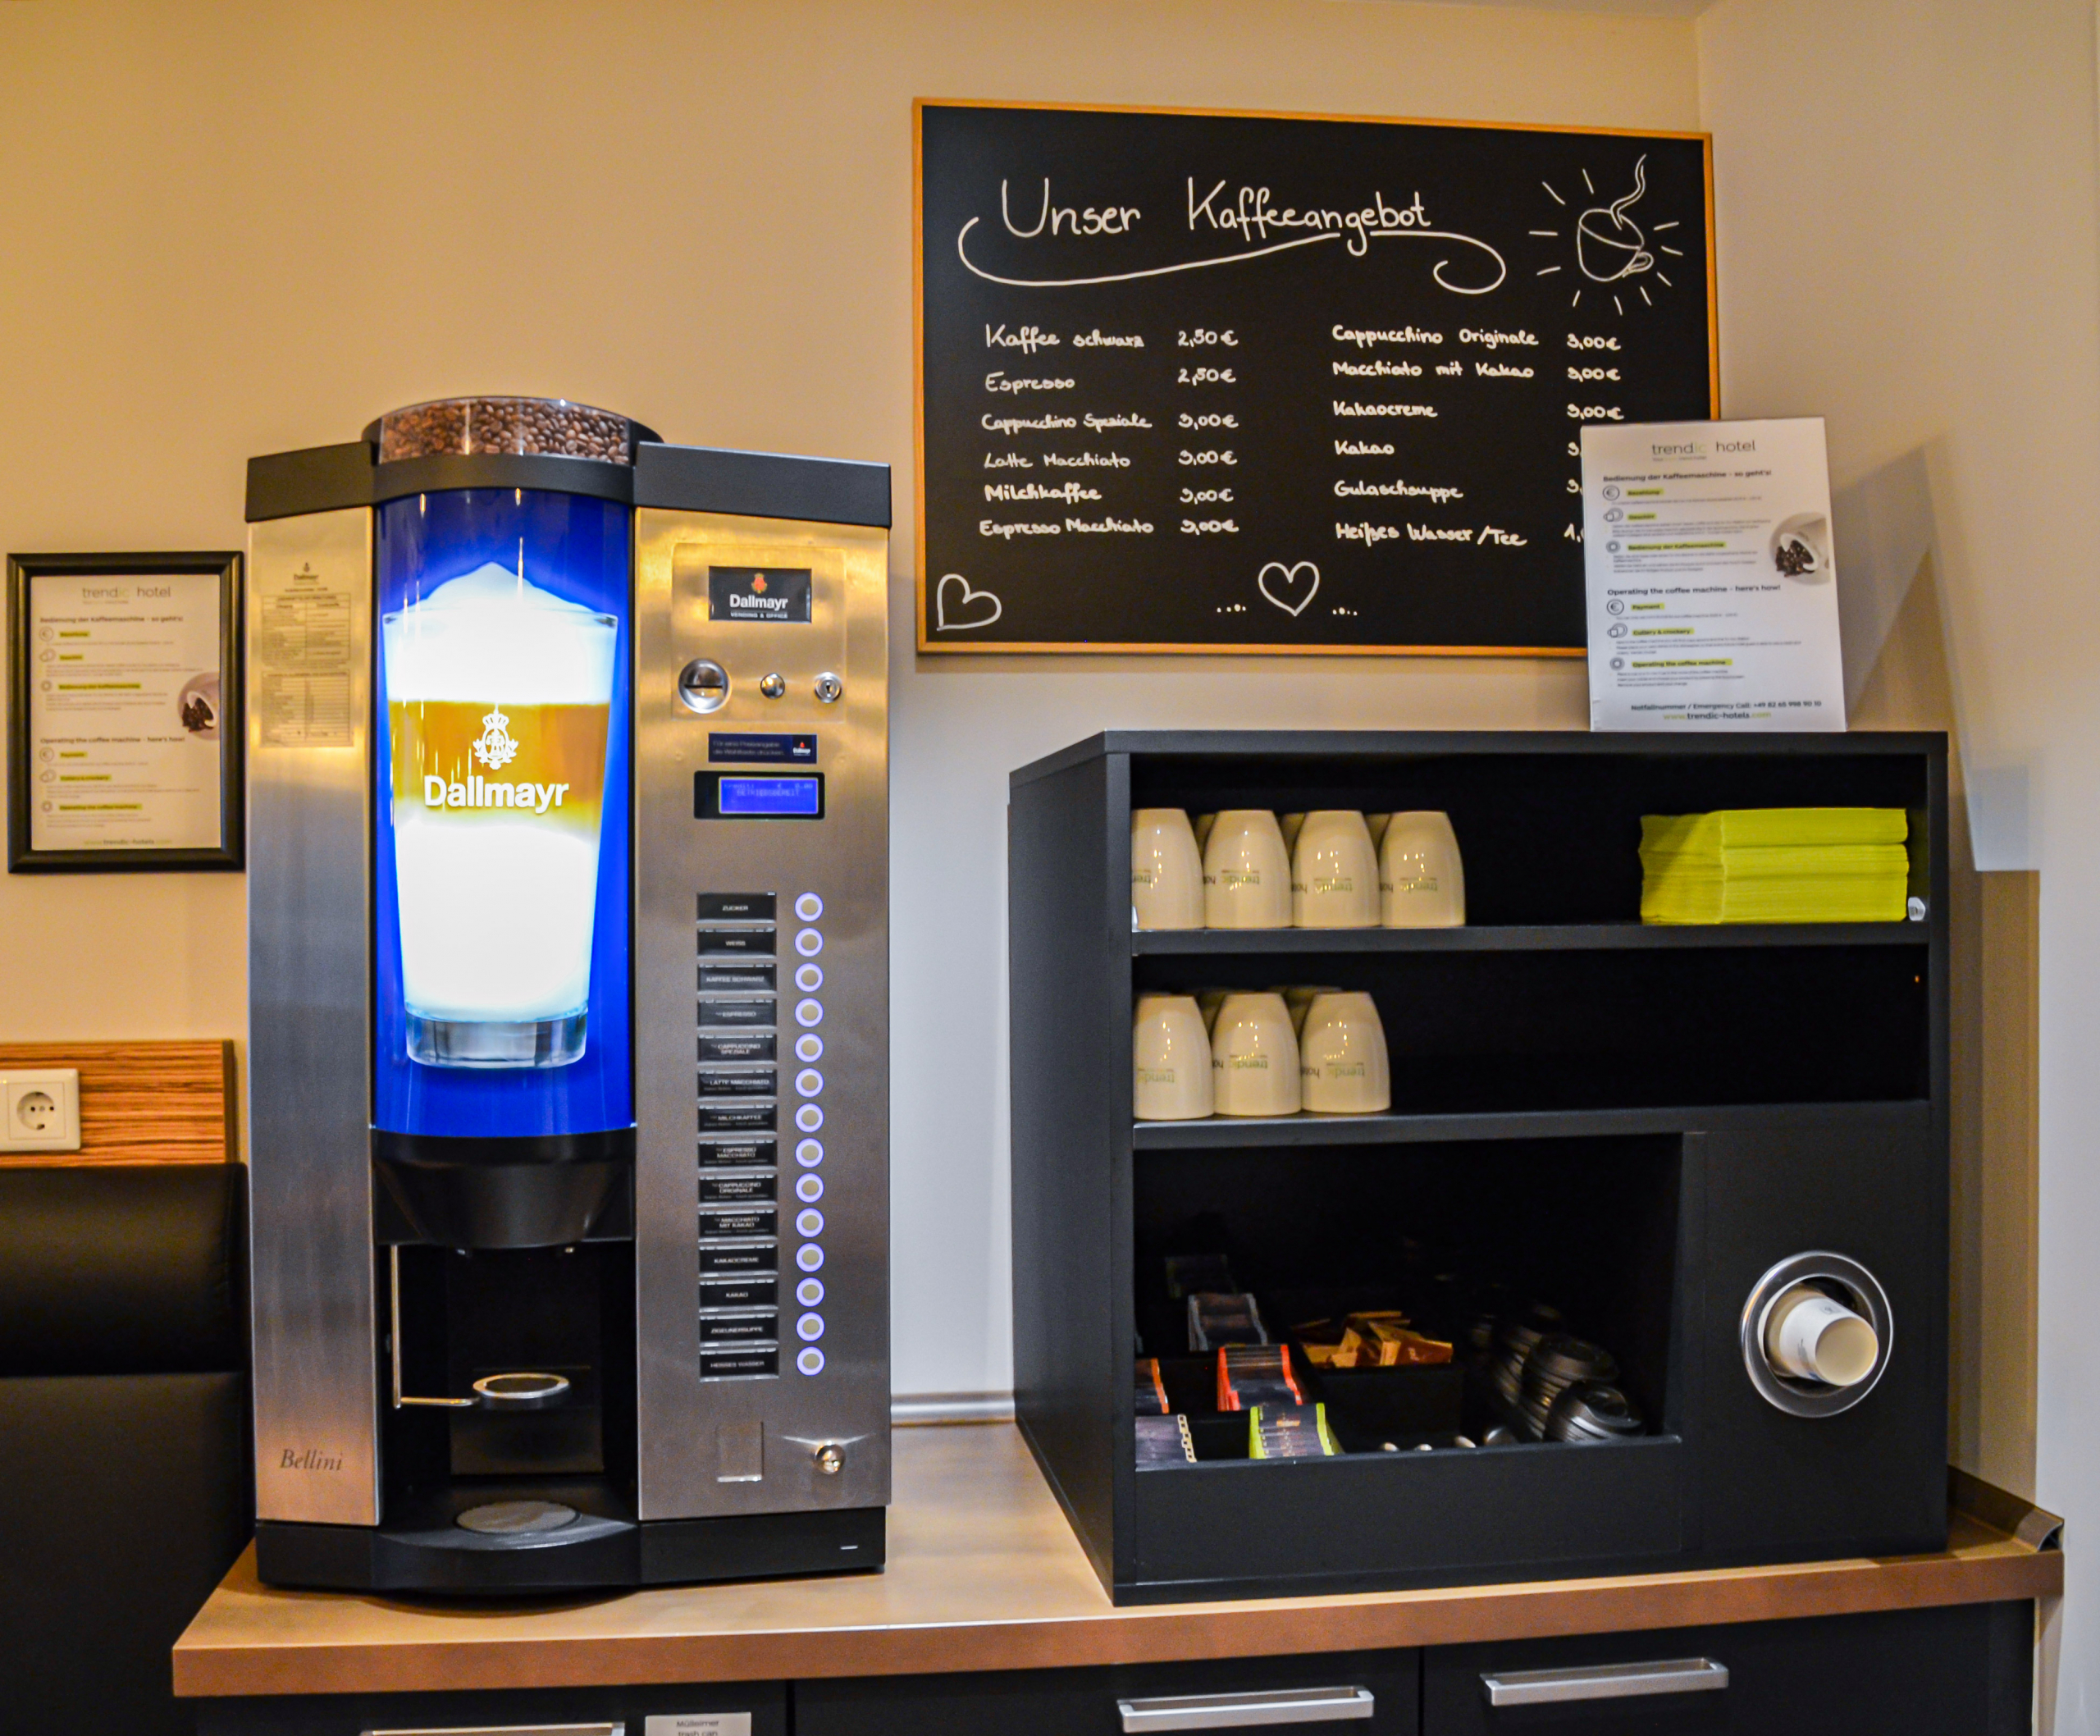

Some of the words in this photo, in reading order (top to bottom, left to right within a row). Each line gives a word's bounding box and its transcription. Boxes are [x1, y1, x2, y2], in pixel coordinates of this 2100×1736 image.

[1001, 177, 1141, 238] Unser
[1187, 176, 1431, 257] Kaffeeangebot
[985, 323, 1061, 354] Kaffee
[1072, 328, 1145, 349] schwarz
[1177, 328, 1239, 348] 2,50€
[1331, 324, 1444, 349] Cappucchino
[1459, 328, 1539, 349] Originale
[1566, 333, 1622, 351] 3,00€
[984, 371, 1075, 395] Espresso
[1177, 367, 1237, 386] 2,50€
[1332, 359, 1422, 377] Macchiato
[1435, 360, 1463, 377] mit
[1475, 362, 1535, 378] Kakao
[1568, 367, 1621, 382] 3,00€
[1332, 400, 1438, 418] Kakaocreme
[1567, 404, 1624, 420] 3,00€
[981, 413, 1077, 436] Cappucchino
[1082, 412, 1153, 433] Speziale
[1178, 413, 1239, 431] 3,00€
[1334, 440, 1395, 455] Kakao
[1567, 441, 1582, 457] 3
[1715, 440, 1756, 452] hotel
[984, 452, 1034, 469] Latte
[1043, 451, 1131, 468] Macchiato
[1178, 450, 1238, 466] 3,00€
[1603, 474, 1646, 482] Bedienung
[1663, 471, 1727, 480] Kaffeemaschine
[984, 482, 1102, 505] Milchkaffee
[1179, 487, 1234, 505] 3,00€
[1334, 479, 1464, 504] Gulaschsuppe
[979, 519, 1061, 541] Espresso
[1065, 516, 1154, 534] Macchiato
[1180, 519, 1239, 536] 3,00€
[1335, 522, 1400, 547] Heißes
[1406, 523, 1473, 541] Wasser
[136, 586, 171, 598] hotel
[729, 593, 788, 611] Dallmayr
[1607, 587, 1649, 596] Operating
[1665, 586, 1691, 594] coffee
[1632, 660, 1665, 669] Operating
[1678, 659, 1698, 667] coffee
[1631, 703, 1687, 711] Notfallnummer
[1692, 702, 1735, 710] Emergency
[40, 737, 75, 745] Operating
[423, 774, 569, 815] Dallmayr
[280, 1448, 343, 1471] Bellini
